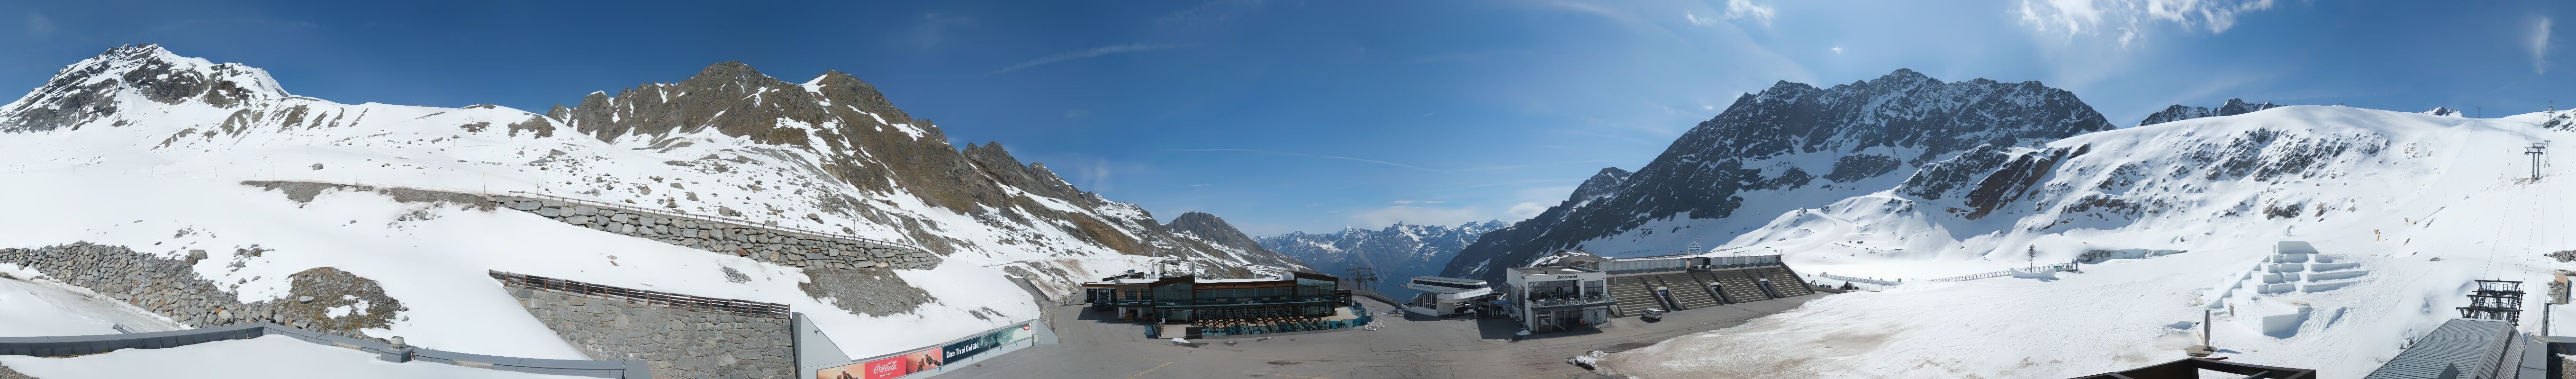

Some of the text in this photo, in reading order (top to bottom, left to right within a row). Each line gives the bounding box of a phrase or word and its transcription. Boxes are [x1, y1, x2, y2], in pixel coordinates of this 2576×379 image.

[946, 342, 979, 359] Das Tirol Gefühl
